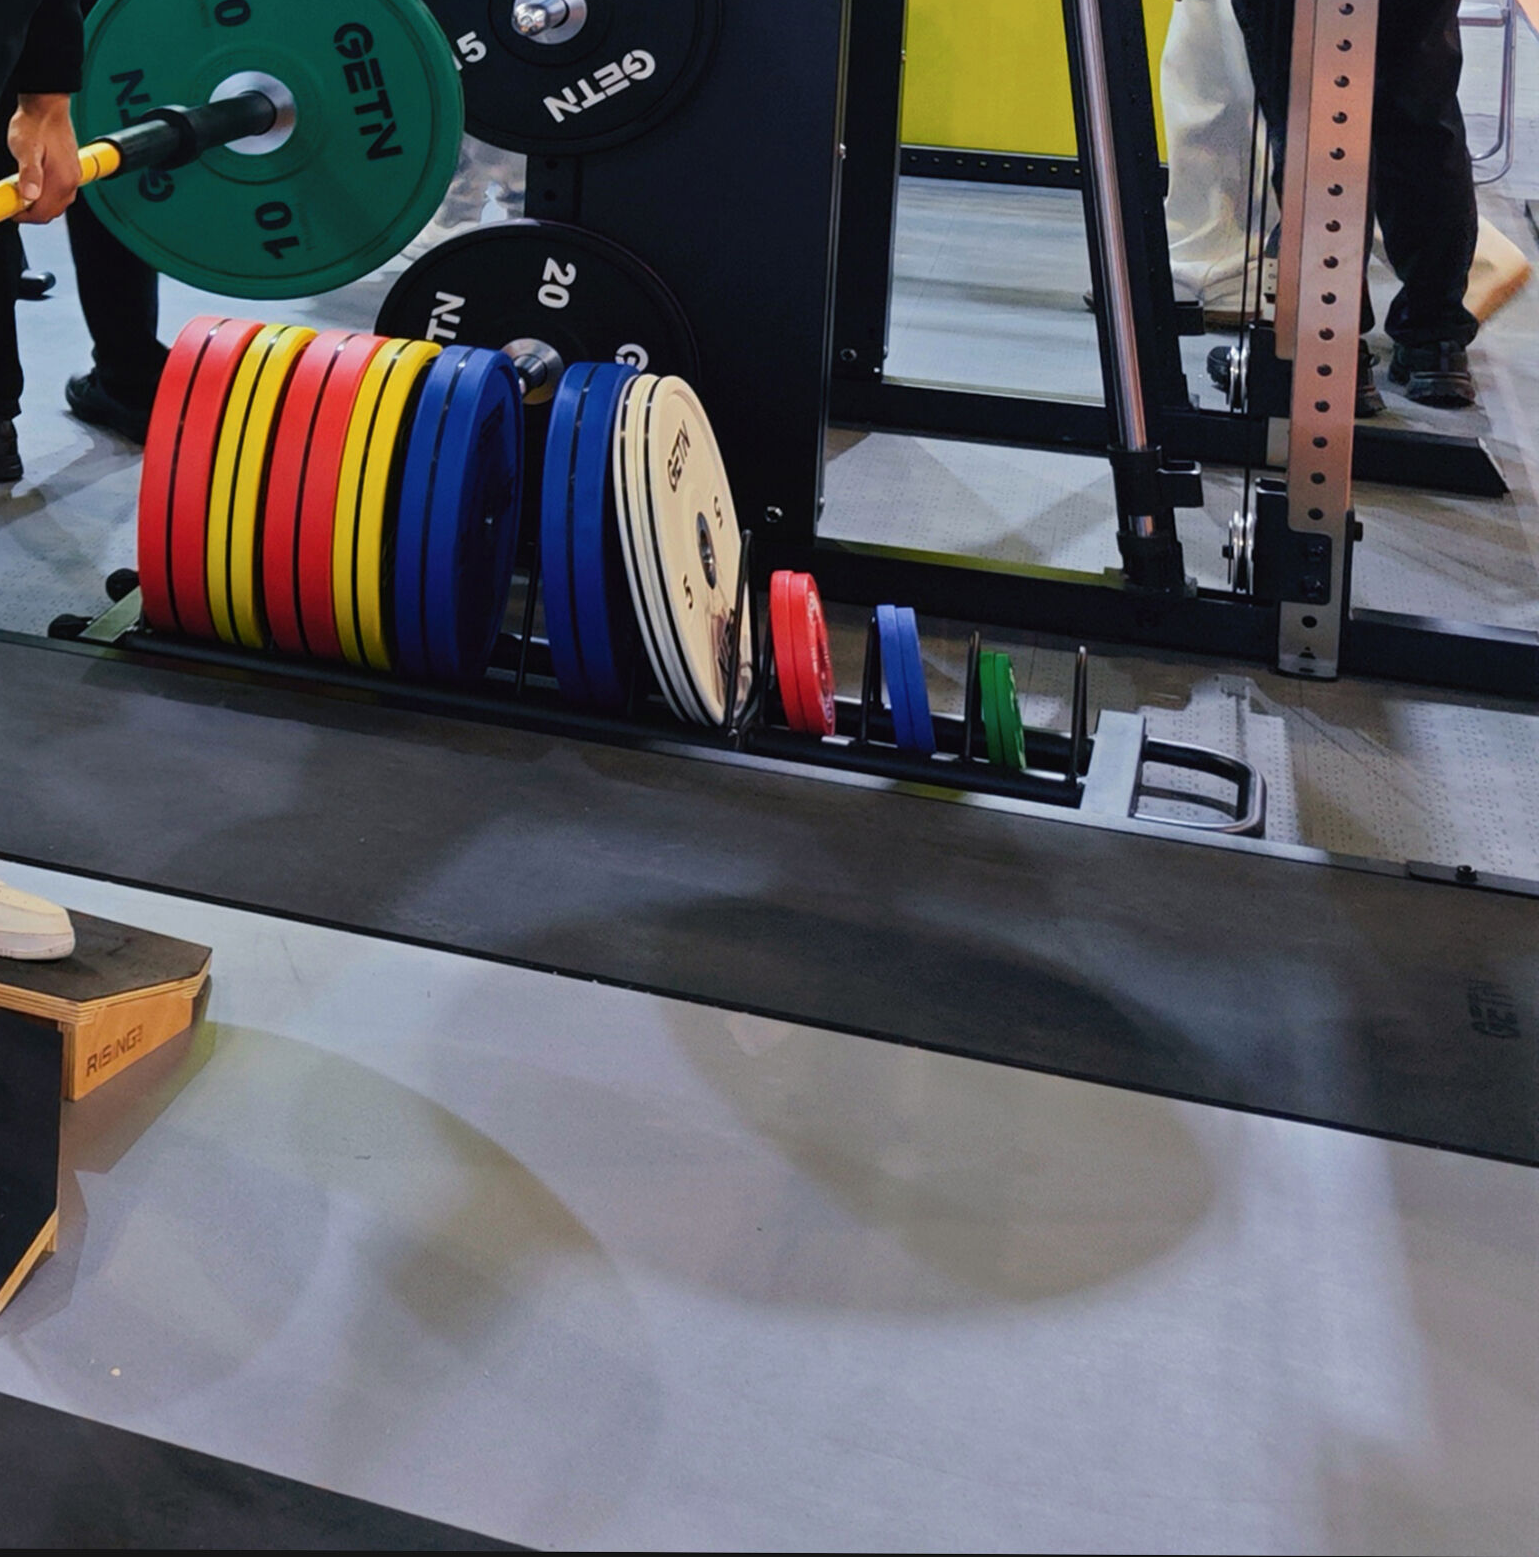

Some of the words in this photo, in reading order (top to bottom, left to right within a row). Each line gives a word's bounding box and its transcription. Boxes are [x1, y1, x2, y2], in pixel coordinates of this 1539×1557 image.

[333, 21, 404, 162] GETN
[542, 49, 657, 123] GETN
[254, 200, 301, 261] 10
[537, 256, 577, 310] 20
[425, 290, 466, 343] TN
[667, 419, 692, 493] GETN
[683, 574, 694, 611] 5
[85, 1022, 142, 1079] RISING
